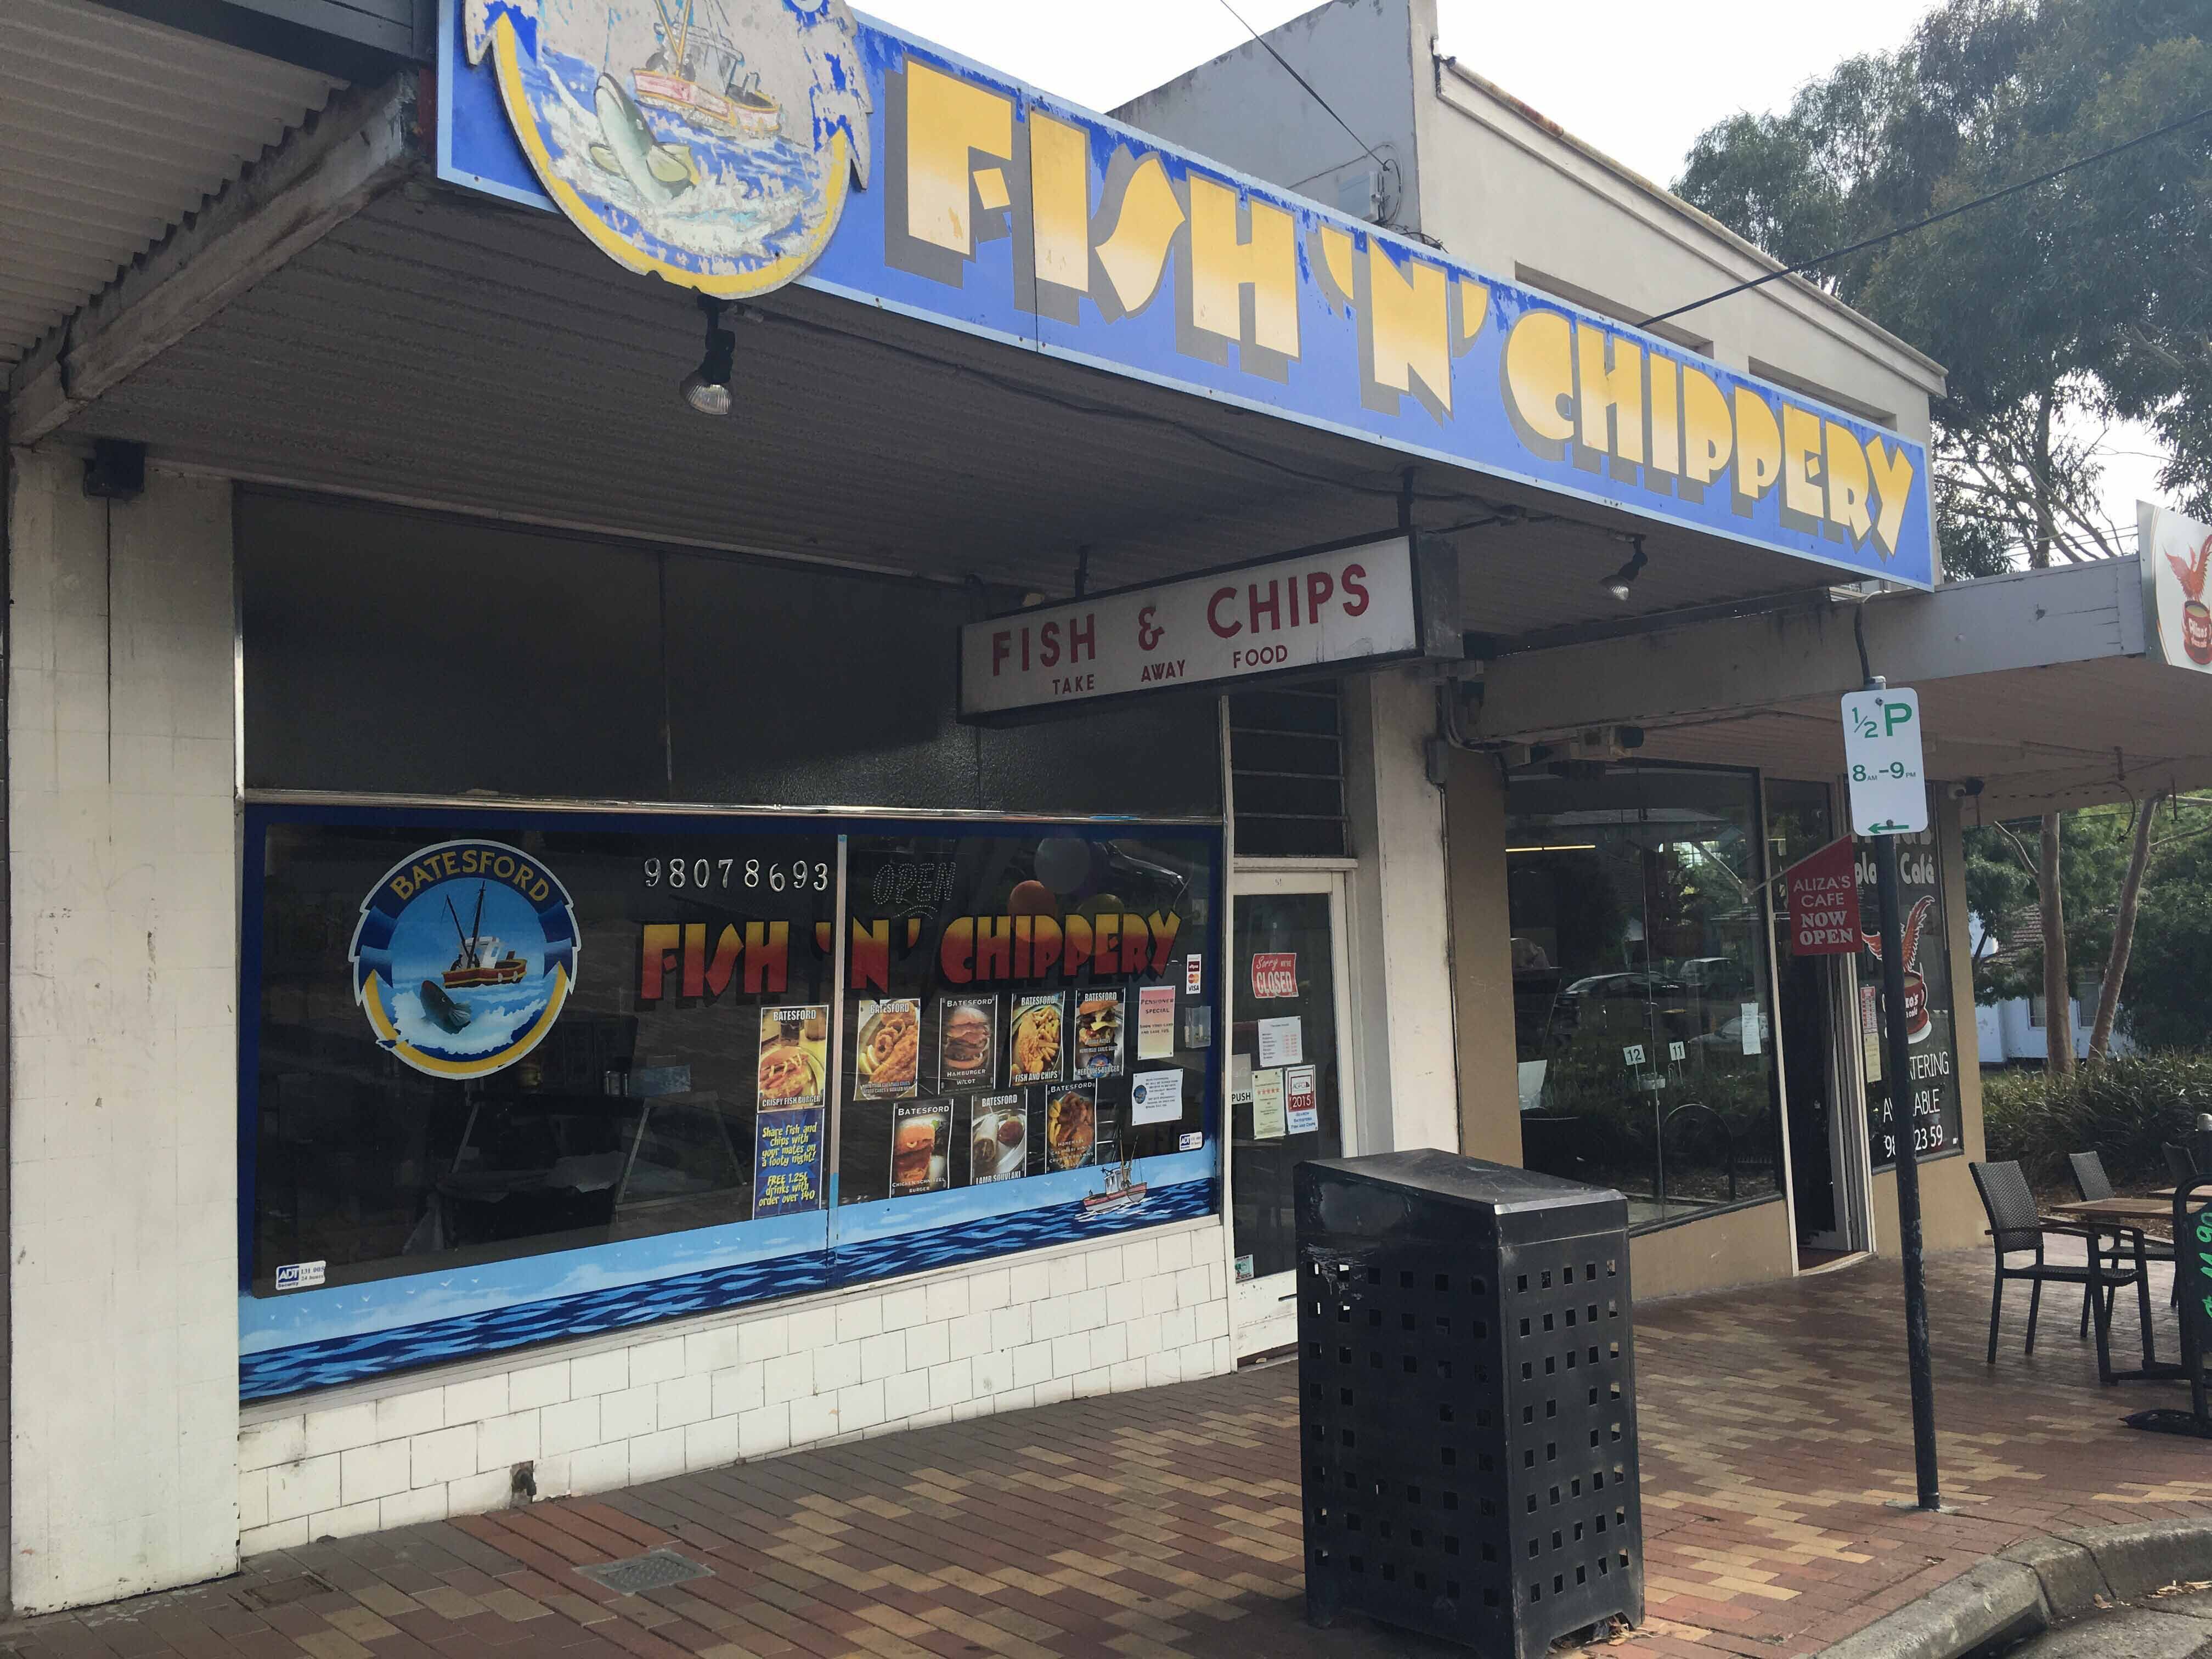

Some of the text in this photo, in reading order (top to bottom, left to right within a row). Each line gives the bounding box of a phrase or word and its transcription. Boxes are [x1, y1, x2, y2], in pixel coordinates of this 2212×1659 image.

[908, 60, 1300, 359] FISH
[1506, 312, 1914, 556] CHIPPERY
[992, 563, 1370, 676] FISH & CHIPS
[1052, 645, 1288, 695] TAKE AWAY FOOD
[390, 850, 549, 901] BATESFORD
[645, 857, 828, 892] 98078693
[873, 862, 957, 905] OPEN
[1793, 876, 1851, 893] ALIZA'S
[1801, 893, 1844, 907] CAFE
[1801, 911, 1848, 928] NOW
[1800, 928, 1853, 945] OPEN
[641, 920, 789, 1000] FISH
[940, 910, 1182, 984] CHIPPERY
[1256, 956, 1278, 970] Sorry
[1256, 971, 1293, 994] CLOSED
[947, 998, 992, 1008] BATESFORD
[1021, 995, 1056, 1006] BATESFORD
[1085, 992, 1117, 1002] BATESFORD
[774, 1009, 817, 1022] BATESFORD
[870, 1003, 910, 1014] BATESFORD
[1627, 1048, 1642, 1062] 12
[1672, 1045, 1682, 1057] 11
[946, 1068, 986, 1077] HAMBURGER
[1015, 1073, 1028, 1083] FISH
[1029, 1072, 1040, 1081] AND
[1041, 1070, 1058, 1080] CHIPS
[1050, 1082, 1092, 1093] BATESFORD
[762, 1095, 821, 1107] CRISPY FISH BURGER
[981, 1094, 1018, 1107] BATESFORD
[1232, 1092, 1251, 1102] PUSH
[1293, 1095, 1311, 1107] 2015
[898, 1105, 950, 1116] BATESFORD
[762, 1122, 817, 1138] Share fish and
[770, 1134, 809, 1147] chips with
[762, 1144, 816, 1159] your mates on
[761, 1151, 816, 1167] a footy night!
[767, 1174, 786, 1186] FREE
[993, 1171, 1021, 1182] SOUVLAKI
[766, 1182, 809, 1196] drinks with
[759, 1189, 815, 1207] order over $40
[279, 1268, 299, 1280] ADT
